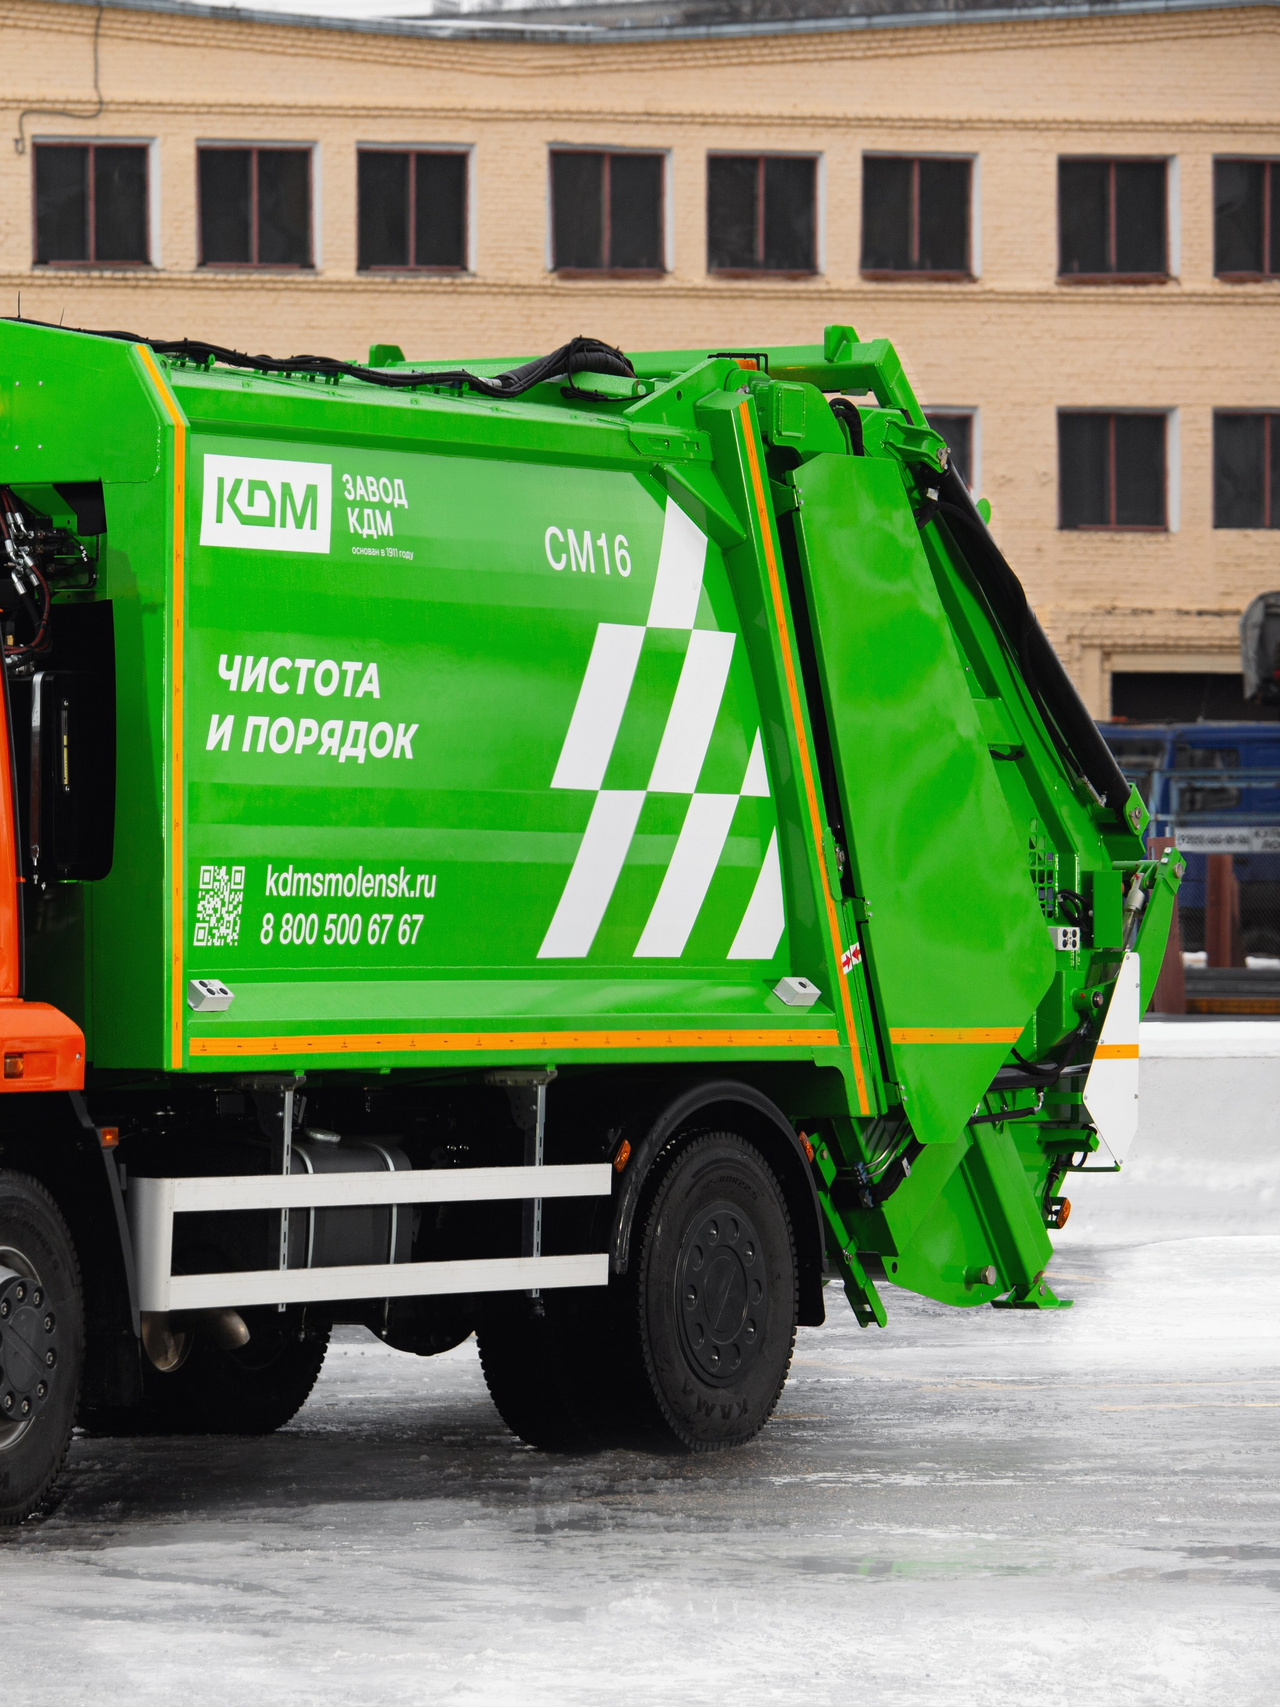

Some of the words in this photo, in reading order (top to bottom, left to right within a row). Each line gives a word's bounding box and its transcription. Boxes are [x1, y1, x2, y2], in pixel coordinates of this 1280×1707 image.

[216, 476, 318, 531] KDM
[341, 473, 409, 509] ЗАВОД
[346, 507, 394, 539] КДМ
[351, 546, 380, 556] основан
[380, 549, 385, 557] в
[385, 547, 399, 558] 1911
[398, 549, 414, 561] году
[217, 653, 381, 699] ЧИСТОТА
[205, 713, 235, 752] И
[241, 714, 419, 764] ПОРЯДОК
[265, 864, 437, 898] kdmsmolensk.ru
[260, 912, 275, 945] 8
[279, 913, 320, 945] 800
[323, 913, 363, 945] 500
[367, 914, 394, 945] 67
[397, 914, 425, 945] 67
